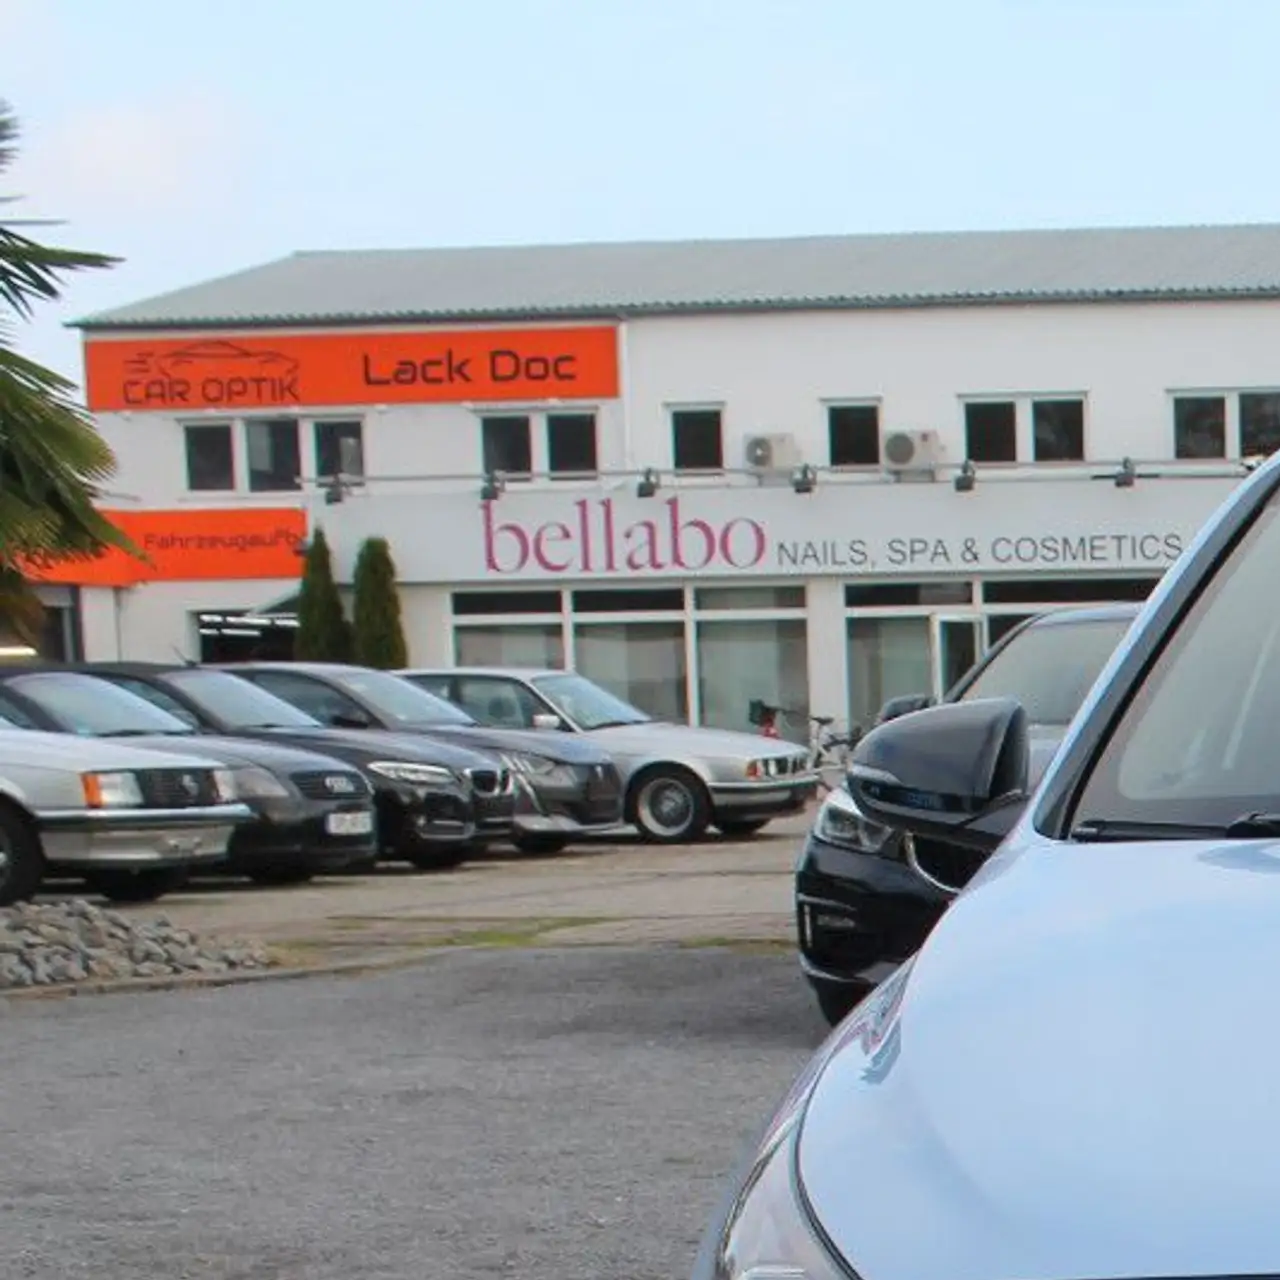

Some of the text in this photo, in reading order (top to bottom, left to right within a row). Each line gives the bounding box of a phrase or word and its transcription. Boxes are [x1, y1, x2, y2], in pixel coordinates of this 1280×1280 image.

[362, 348, 577, 386] Lack Doc
[122, 375, 300, 405] CAR OPTIK
[479, 496, 766, 574] bellabo
[777, 533, 1184, 570] NAILS, SPA & COSMETICS
